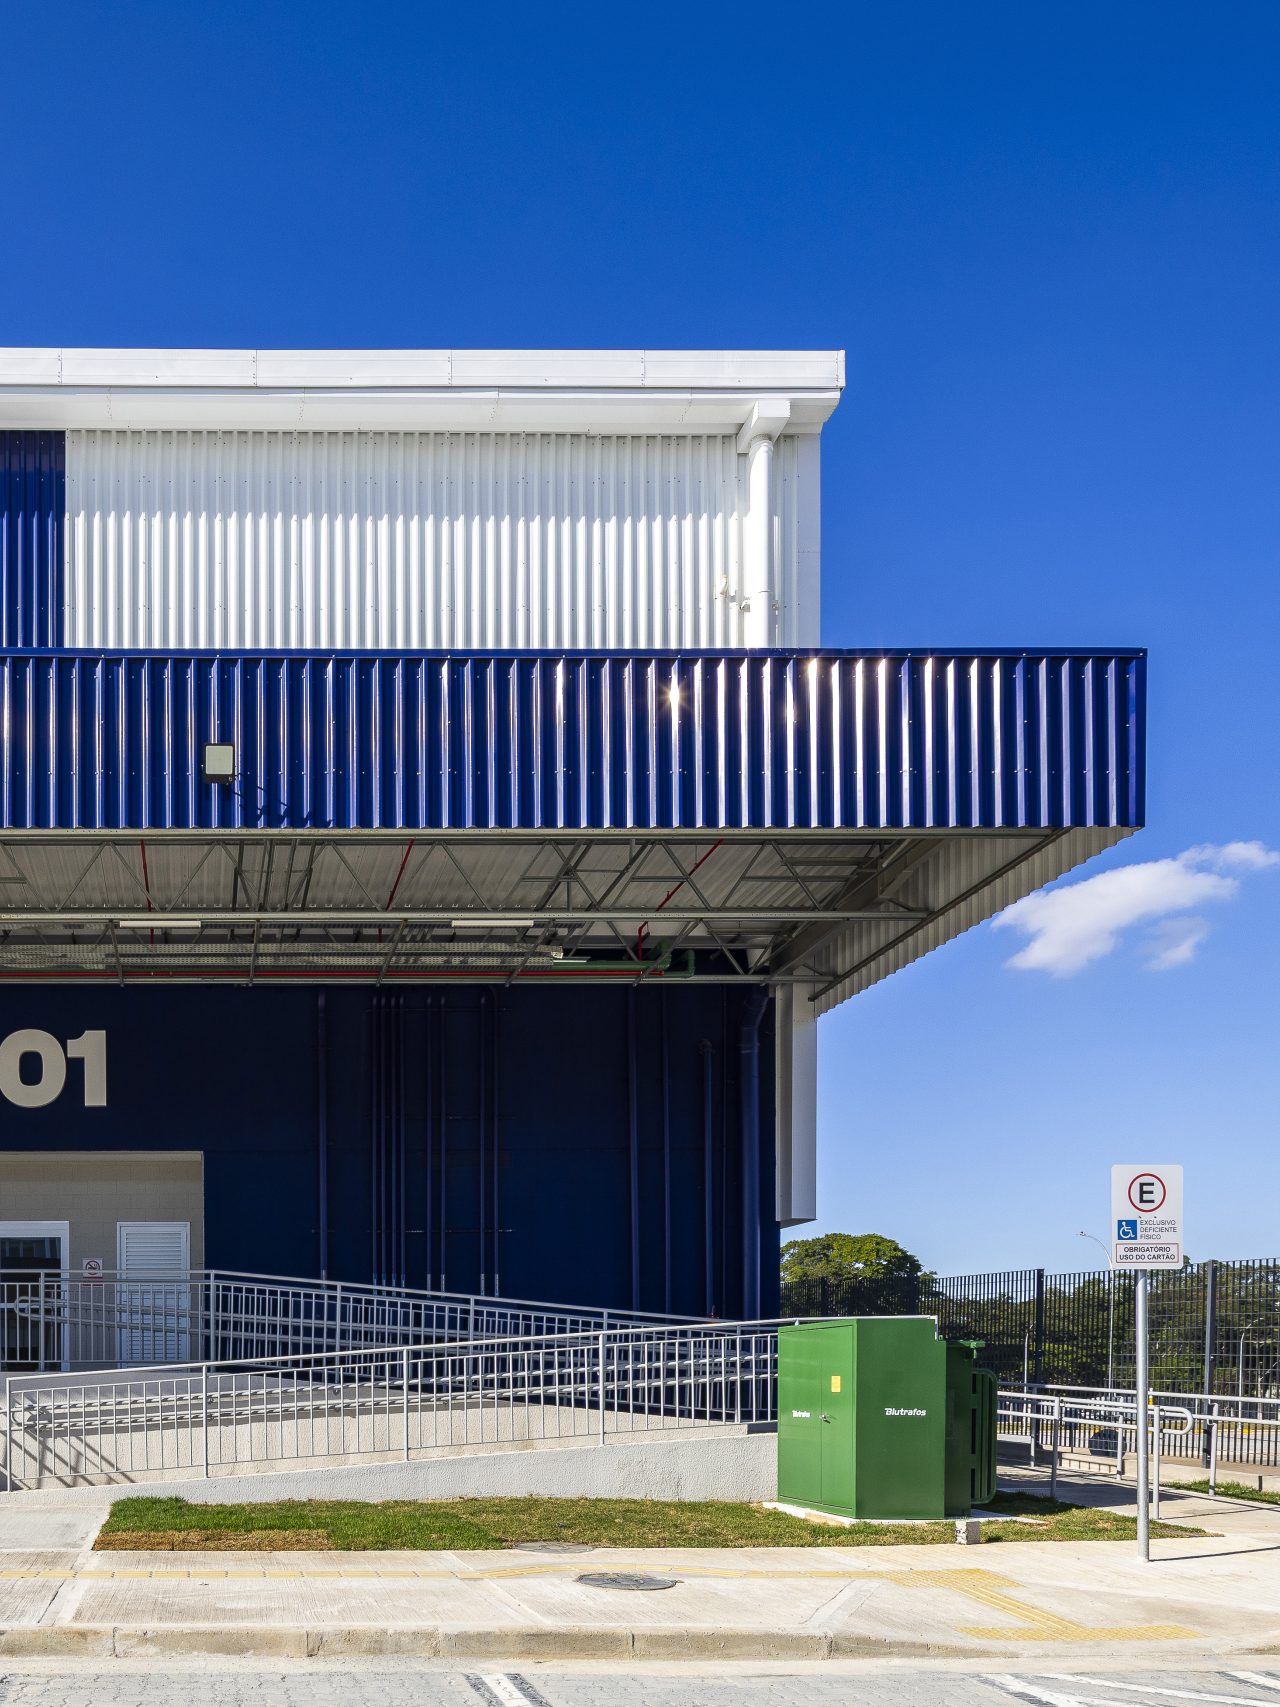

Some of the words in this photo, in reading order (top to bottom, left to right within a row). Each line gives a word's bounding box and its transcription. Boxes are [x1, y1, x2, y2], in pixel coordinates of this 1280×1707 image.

[1138, 1182, 1155, 1204] E
[1123, 1245, 1171, 1253] OBRIGATÓRIO
[1146, 1252, 1176, 1261] CARTÃO
[884, 1407, 927, 1417] Blutrafos
